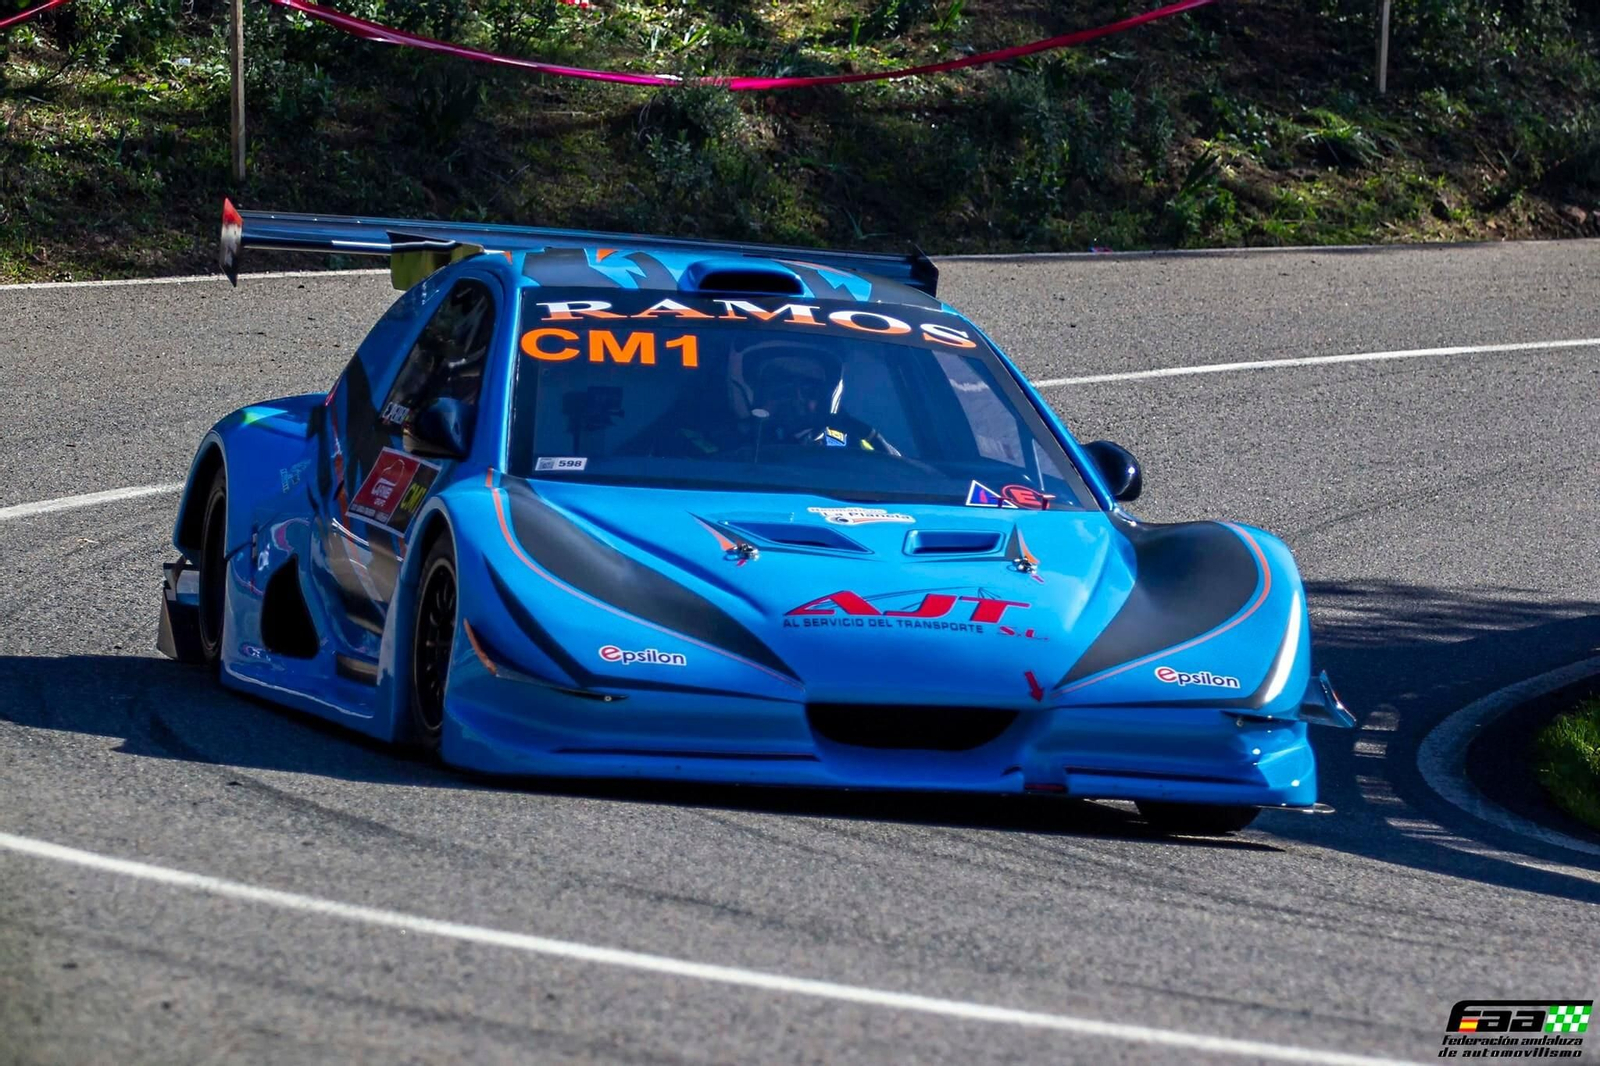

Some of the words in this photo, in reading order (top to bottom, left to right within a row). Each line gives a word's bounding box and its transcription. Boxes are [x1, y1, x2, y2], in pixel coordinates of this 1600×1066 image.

[536, 298, 977, 349] RAMOS
[520, 328, 699, 368] CM1
[558, 460, 583, 468] 598
[847, 510, 911, 521] Planeta
[784, 590, 1030, 624] AJT
[782, 617, 800, 628] AL
[803, 617, 865, 628] SERVICIO
[868, 619, 893, 629] DEL
[898, 620, 984, 634] TRANSPORTE
[600, 646, 685, 664] epsilon
[1157, 668, 1239, 687] epsilon
